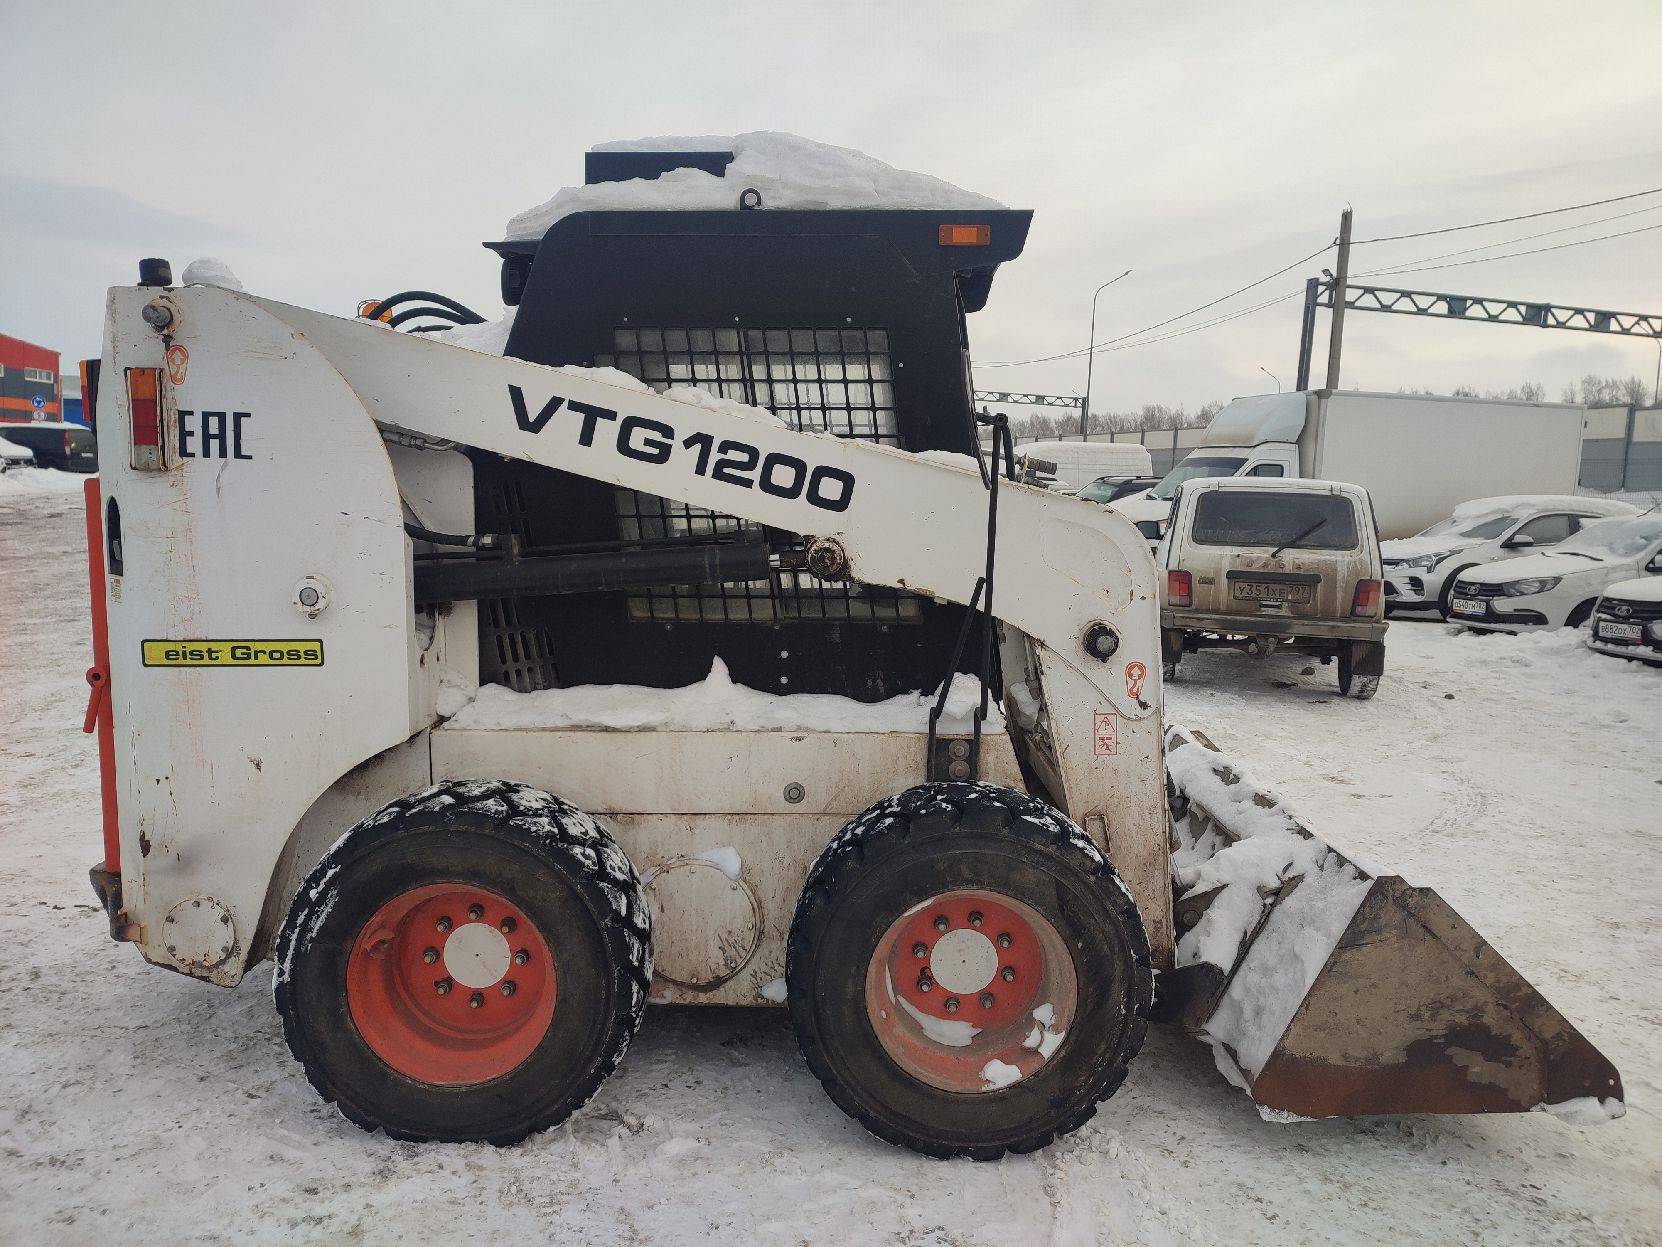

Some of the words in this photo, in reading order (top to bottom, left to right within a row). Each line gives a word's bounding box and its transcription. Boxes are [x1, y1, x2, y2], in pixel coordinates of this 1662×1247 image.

[177, 409, 253, 460] EAC
[507, 383, 856, 513] VTG1200
[230, 645, 319, 661] Gross
